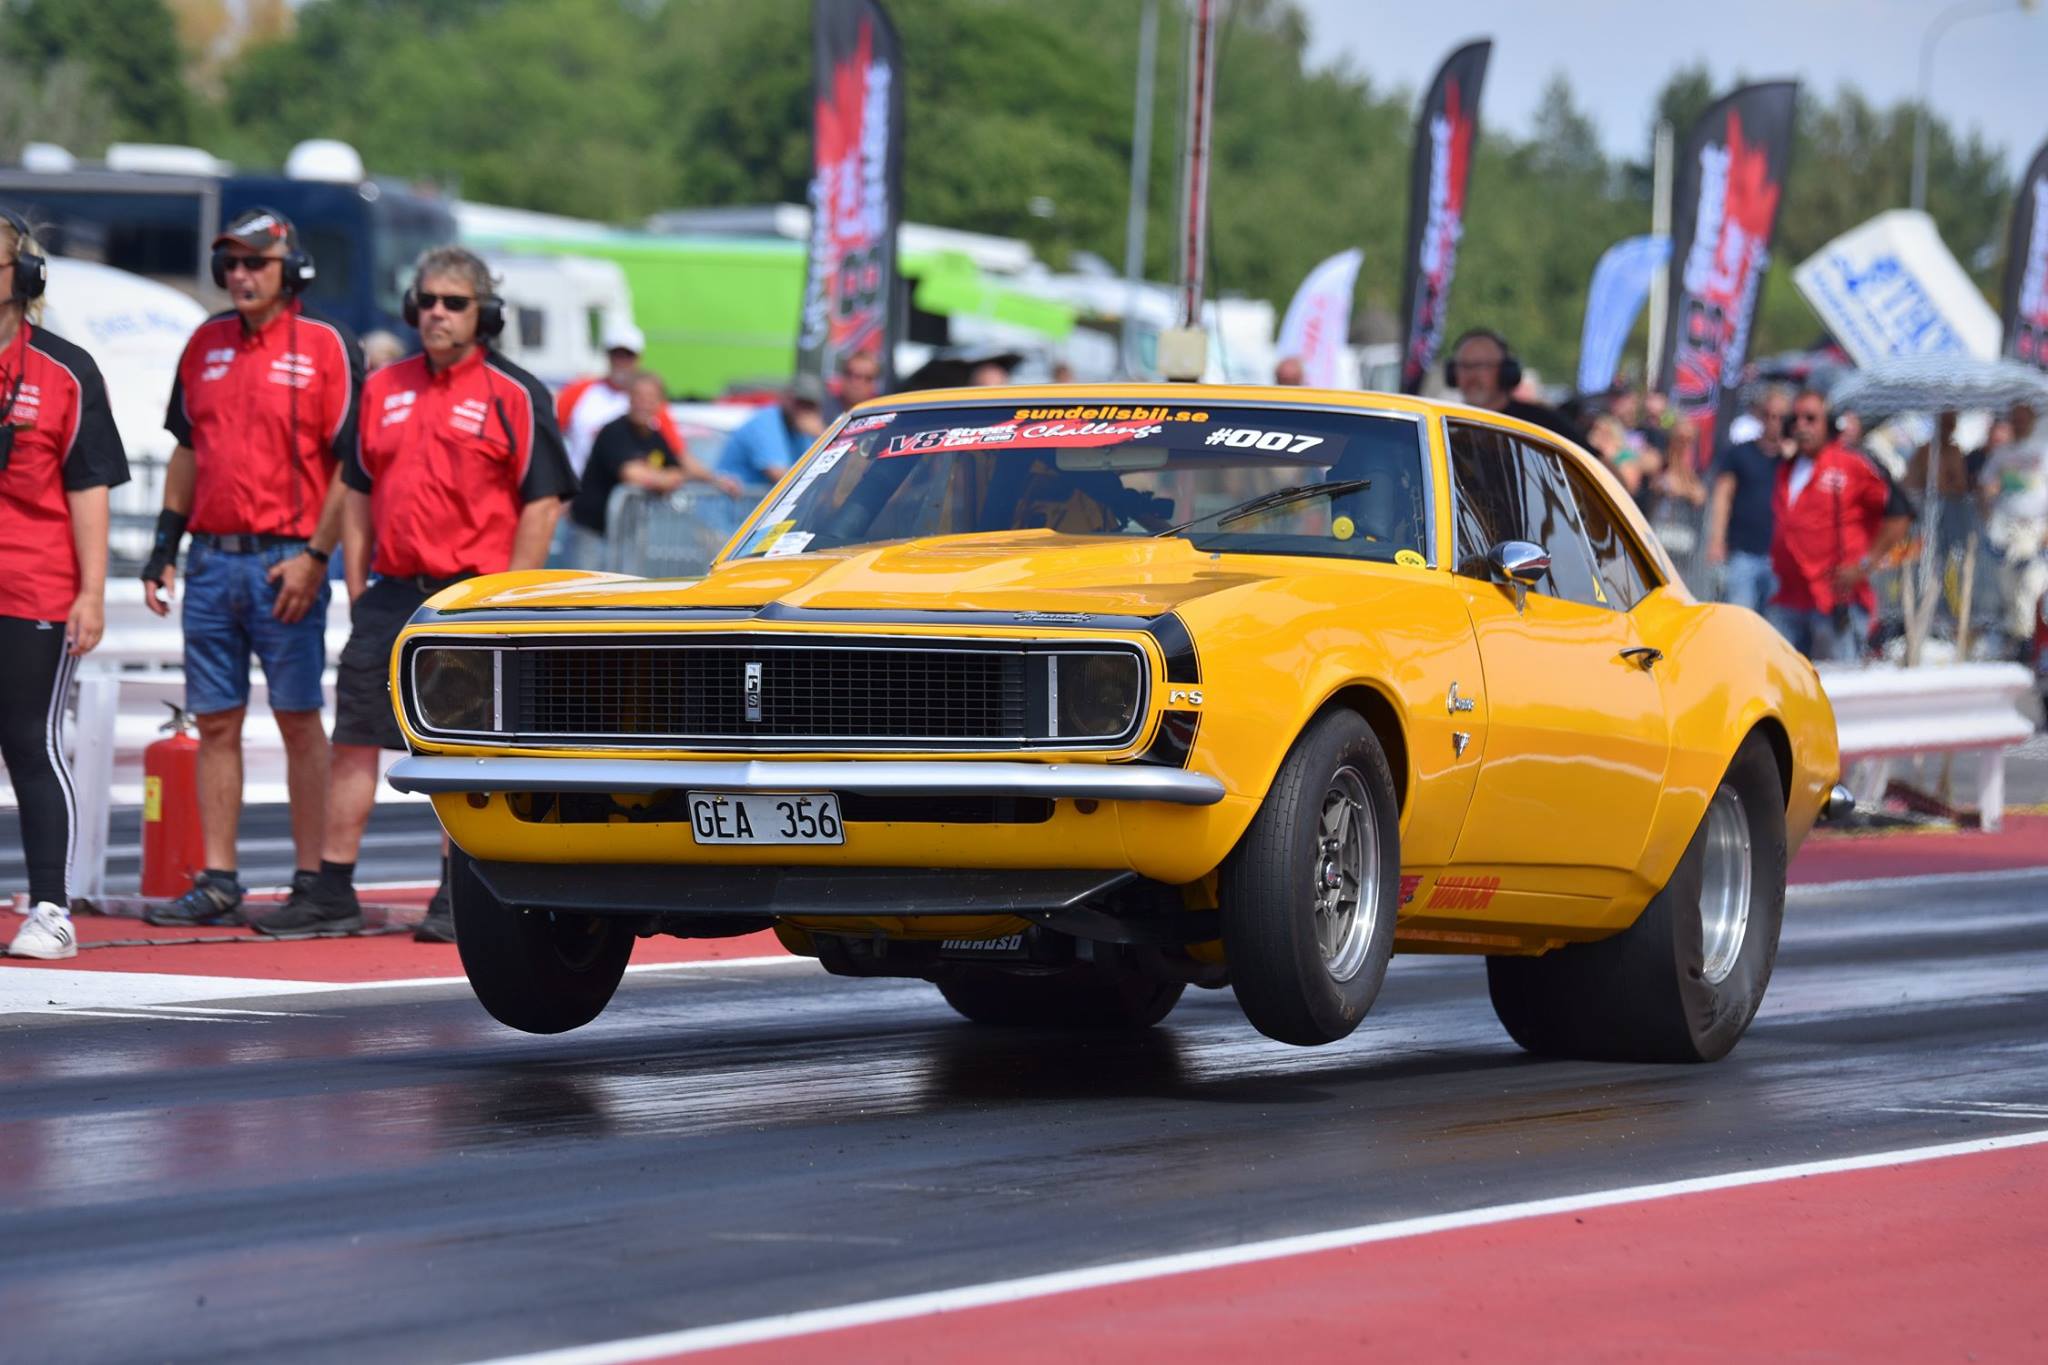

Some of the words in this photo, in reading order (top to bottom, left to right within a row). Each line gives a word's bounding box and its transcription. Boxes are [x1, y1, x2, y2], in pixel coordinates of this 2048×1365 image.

[1014, 406, 1209, 422] sundellsbil.se
[889, 429, 950, 454] V8
[1022, 420, 1162, 439] Challenge
[1205, 427, 1324, 453] #007
[694, 801, 754, 838] GEA
[776, 802, 838, 838] 356
